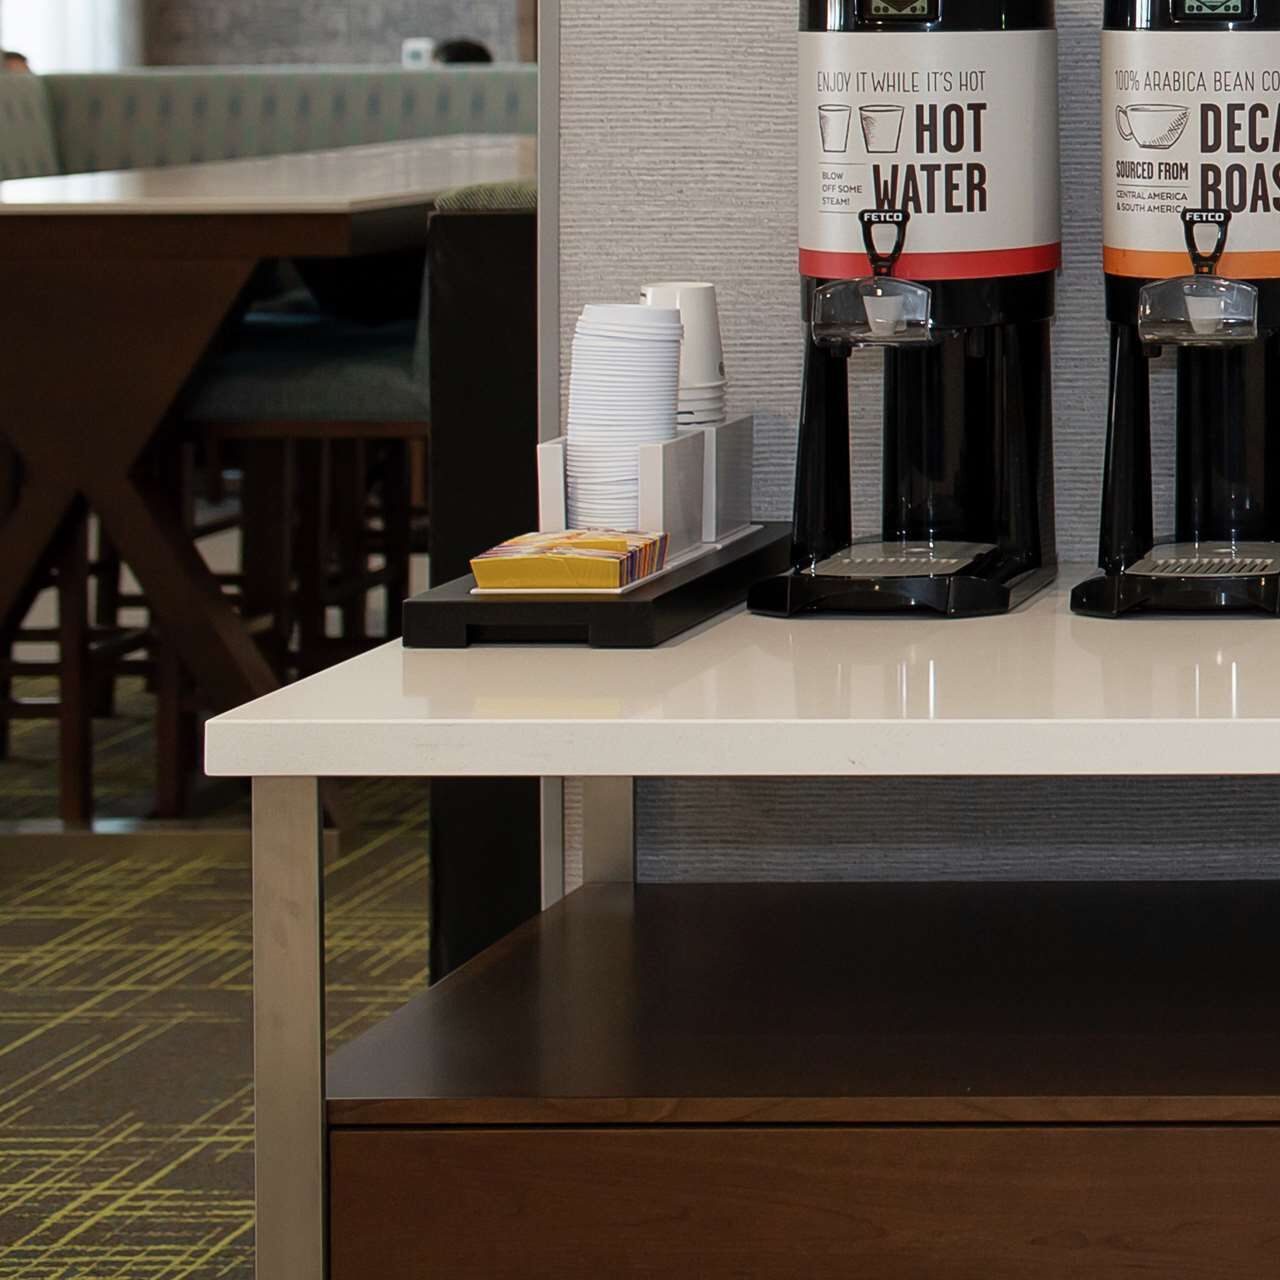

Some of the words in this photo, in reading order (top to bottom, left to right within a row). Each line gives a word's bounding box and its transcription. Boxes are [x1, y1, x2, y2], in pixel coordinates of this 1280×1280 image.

[817, 71, 851, 93] ENJOY
[856, 71, 867, 93] IT
[871, 71, 920, 93] WHILE
[926, 70, 953, 93] IT'S
[959, 70, 986, 92] HOT
[1114, 70, 1140, 92] 100%
[1144, 70, 1207, 92] ARABICA
[1214, 70, 1255, 92] BEAN
[916, 103, 987, 153] HOT
[1116, 160, 1154, 180] SOURCED
[1158, 162, 1189, 180] FROM
[822, 171, 844, 180] BLOW
[822, 184, 836, 194] OFF
[838, 184, 863, 195] SOME
[872, 163, 988, 213] WATER
[1116, 190, 1145, 200] CENTRAL
[1147, 192, 1188, 200] AMERICA
[822, 197, 850, 207] STEAM!
[1121, 202, 1145, 211] SOUTH
[863, 212, 903, 221] FETCO
[1185, 212, 1225, 221] FETCO
